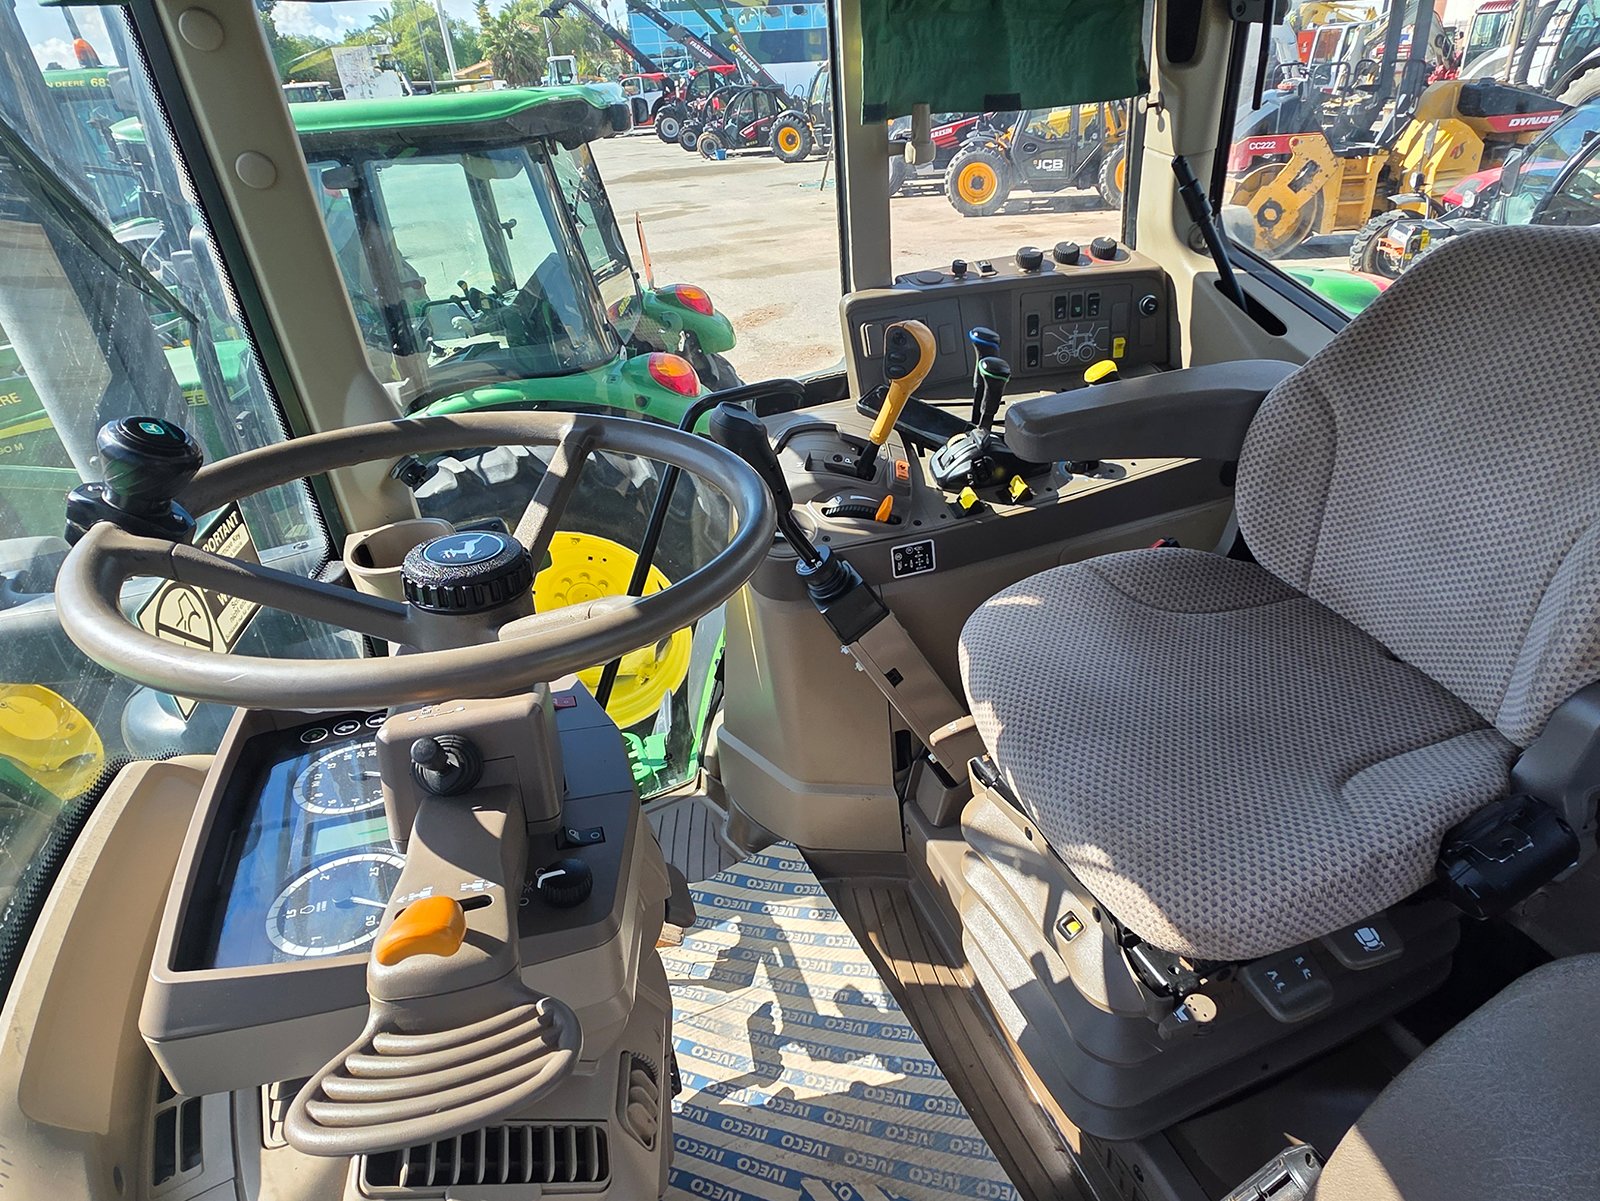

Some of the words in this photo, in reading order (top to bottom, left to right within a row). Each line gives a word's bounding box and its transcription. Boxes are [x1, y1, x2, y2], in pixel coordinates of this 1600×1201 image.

[55, 80, 86, 88] DEERE
[1508, 115, 1559, 127] DYNAP
[930, 127, 953, 140] ARESIN
[1249, 141, 1276, 150] CC222
[1036, 158, 1064, 170] JCB
[202, 510, 239, 553] PORTANT
[743, 855, 769, 867] IVE
[779, 860, 810, 872] VECO
[711, 873, 737, 884] IVE
[746, 878, 784, 892] IVECO
[793, 885, 826, 896] VECO
[713, 897, 751, 910] IVECO
[761, 904, 799, 917] IVECO
[808, 909, 842, 921] VECO
[727, 922, 765, 938] IVECO
[776, 930, 814, 944] IVECO
[825, 934, 860, 947] VECO
[664, 960, 693, 975] IVEC
[793, 957, 831, 972] IVECO
[842, 964, 878, 978] VECO
[670, 986, 707, 1000] IVECO
[809, 985, 848, 1001] IVECO
[863, 993, 899, 1008] VECO
[825, 1018, 868, 1034] IVECO
[881, 1027, 919, 1040] VECO
[691, 1046, 736, 1067] IVECO
[803, 1074, 851, 1094] IVECO
[863, 1087, 911, 1106] IVECO
[763, 1096, 810, 1117] IVECO
[720, 1118, 768, 1140] IVECO
[823, 1111, 872, 1133] IVECO
[885, 1126, 934, 1147] IVECO
[676, 1138, 725, 1163] IVECO
[781, 1134, 831, 1158] IVECO
[737, 1158, 787, 1183] IVECO
[844, 1152, 894, 1174] IVECO
[909, 1167, 961, 1190] IVECO
[976, 1181, 1018, 1201] VECO
